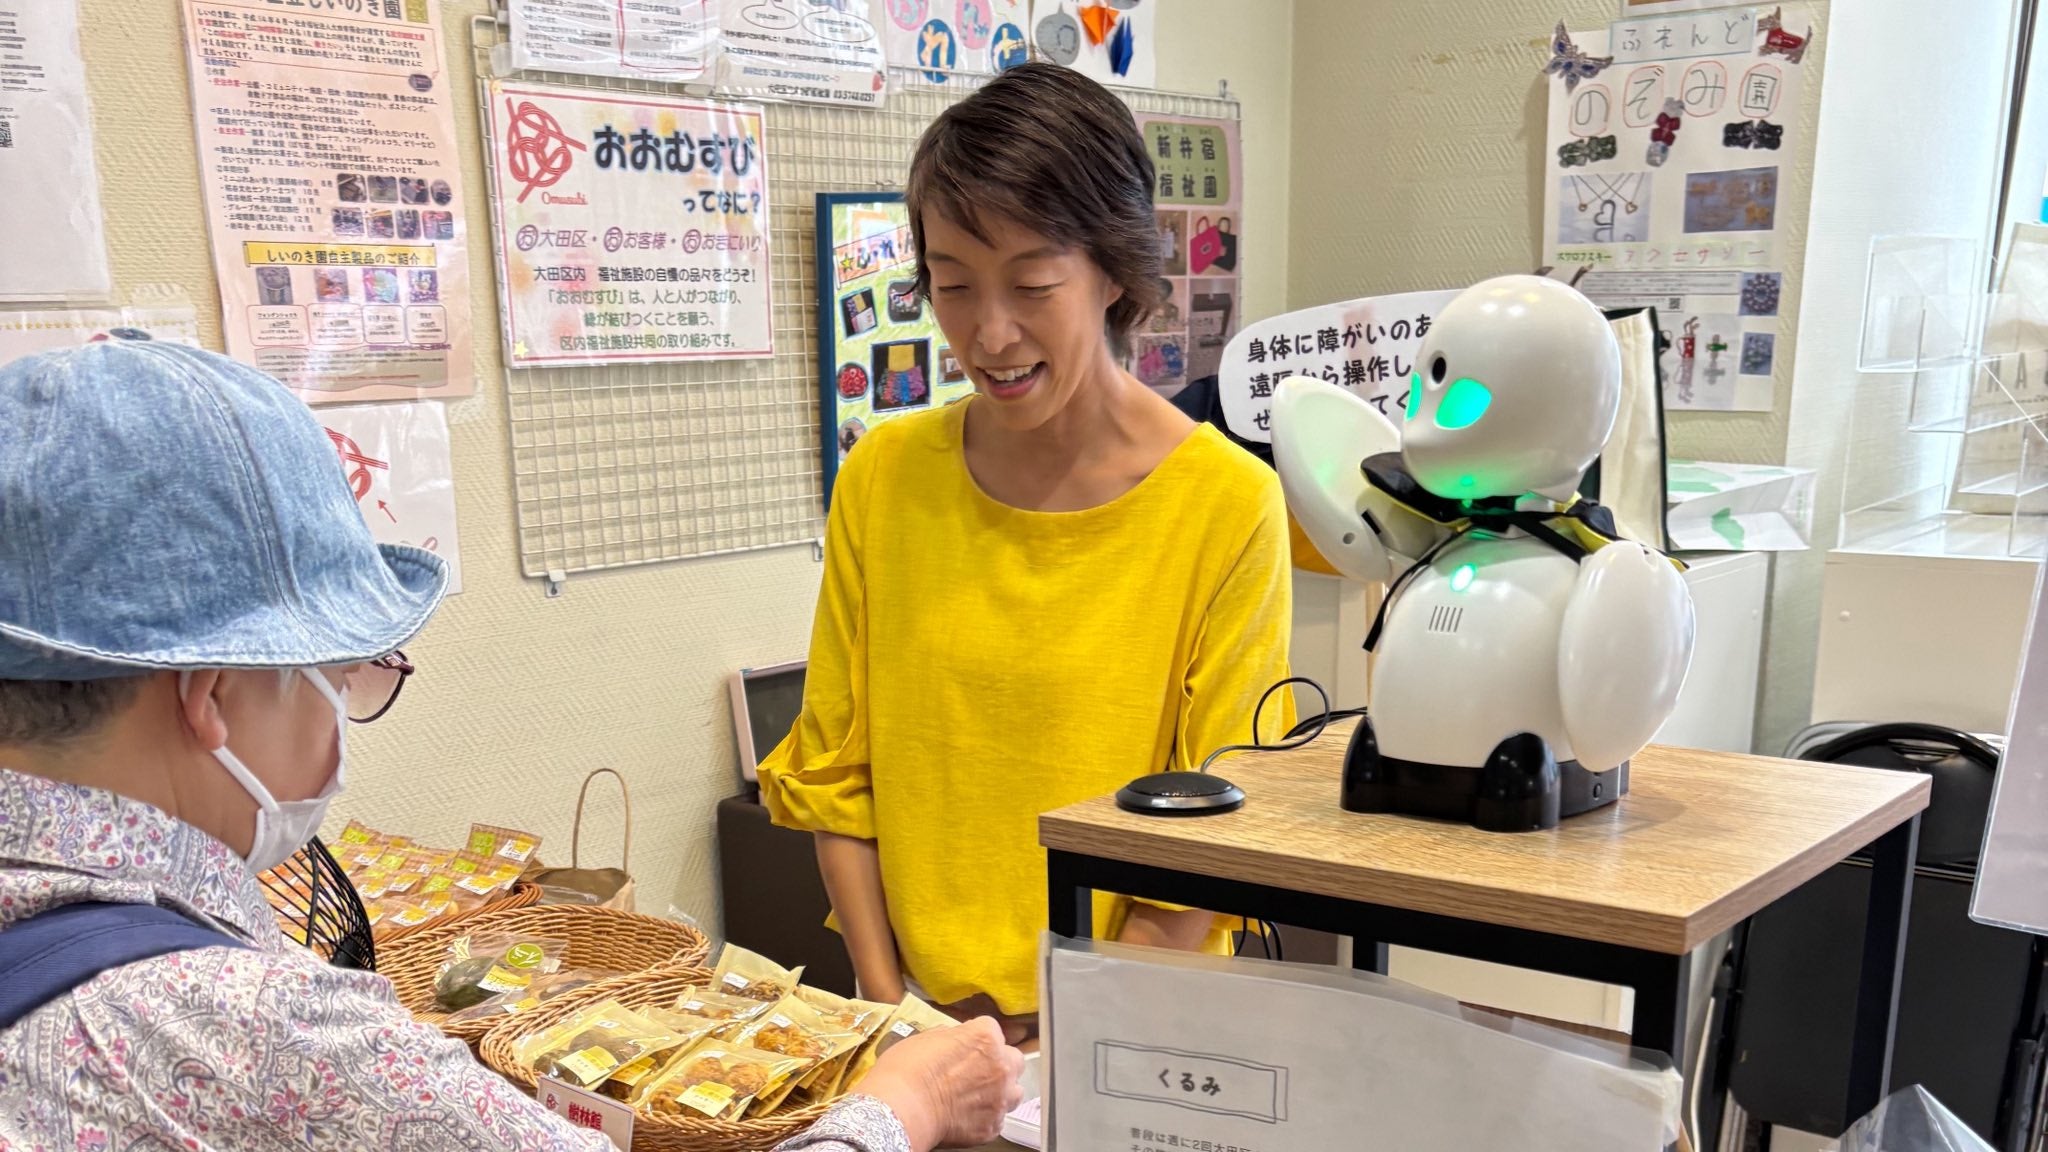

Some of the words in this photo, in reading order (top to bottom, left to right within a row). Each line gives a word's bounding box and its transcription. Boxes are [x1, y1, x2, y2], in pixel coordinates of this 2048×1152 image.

[593, 125, 754, 177] おおむすび
[1157, 134, 1215, 160] 新井宿
[1159, 173, 1217, 198] 福祉園
[682, 189, 761, 215] ってなに？
[533, 267, 586, 282] 大田区内
[1247, 314, 1432, 364] 身体に障がいのあ
[1158, 1068, 1221, 1096] くるみ
